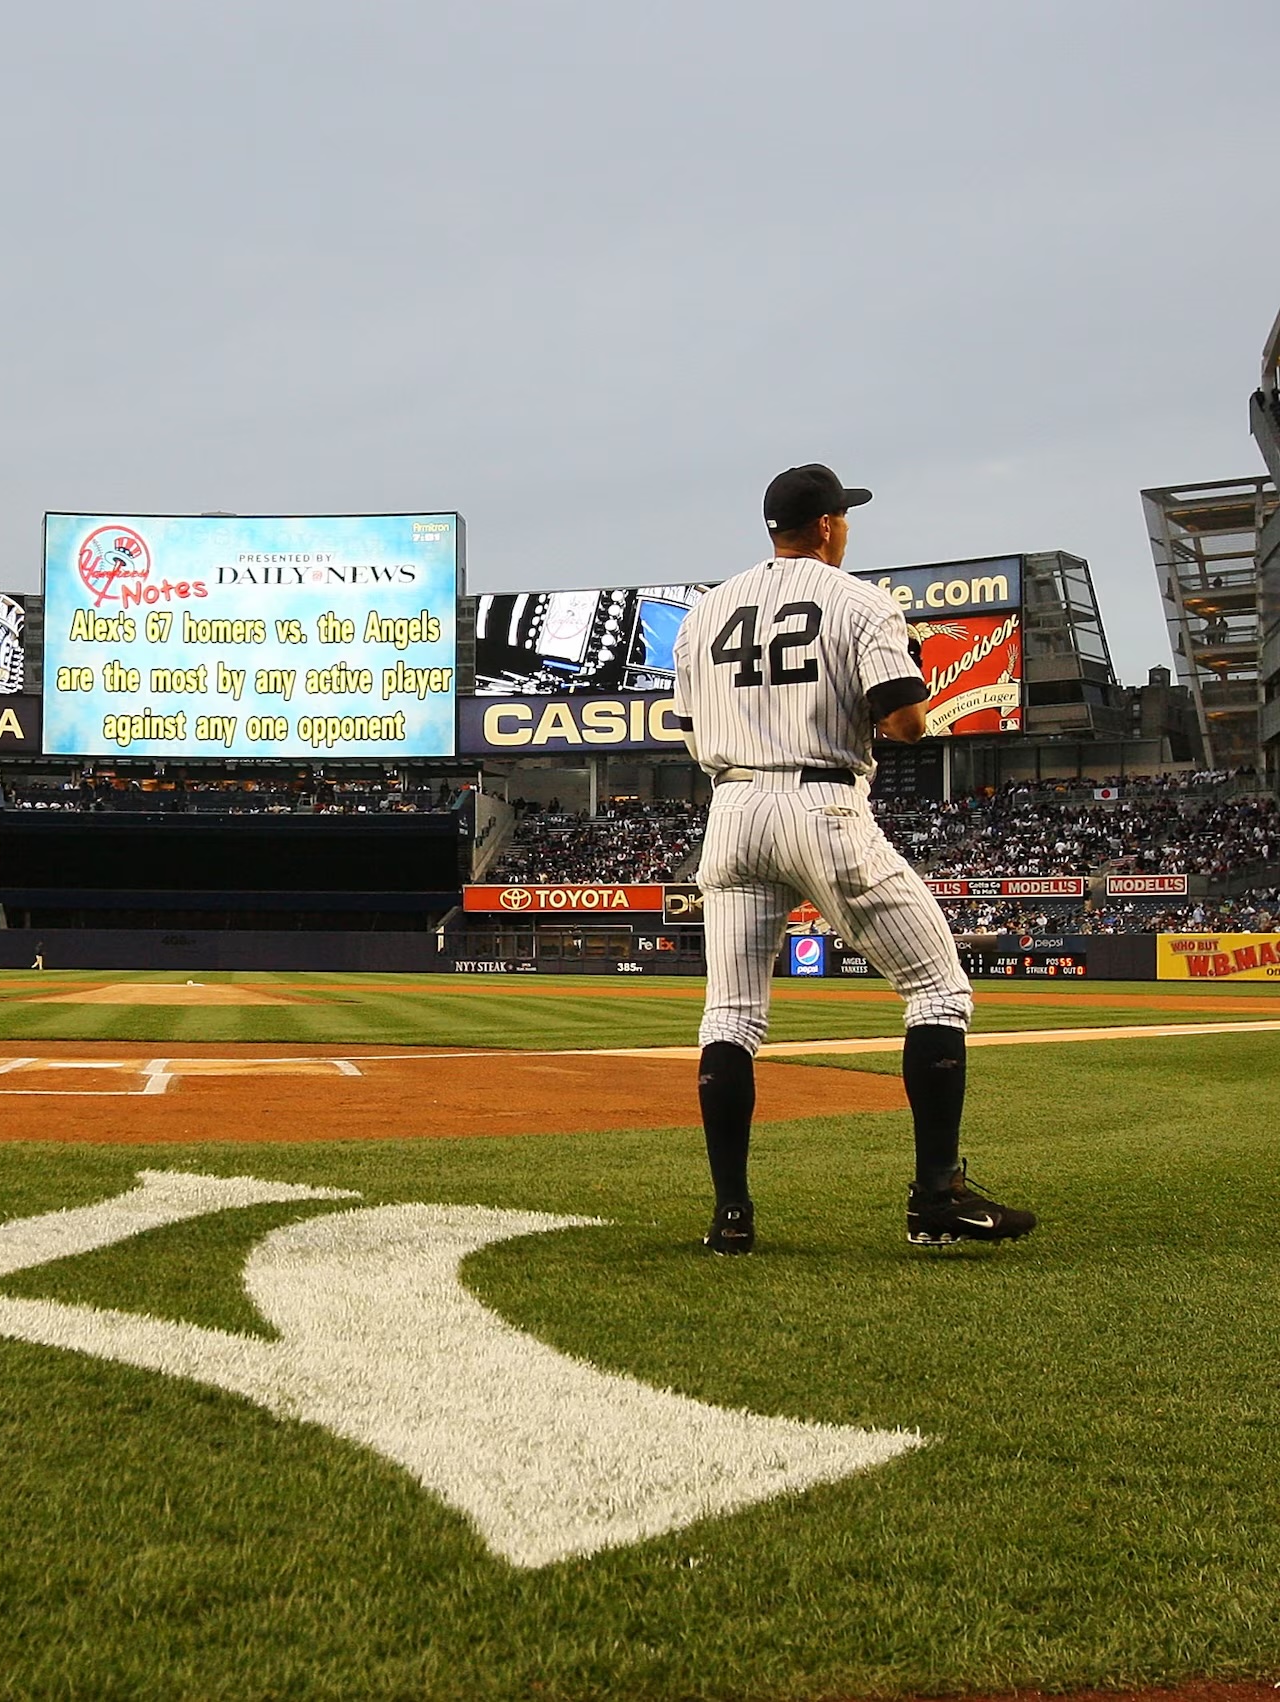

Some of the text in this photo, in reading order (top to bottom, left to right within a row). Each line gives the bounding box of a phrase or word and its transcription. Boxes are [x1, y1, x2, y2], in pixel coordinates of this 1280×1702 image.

[413, 523, 450, 532] Armitron
[239, 554, 332, 563] PRESENTED BY
[215, 565, 416, 584] DAILY NEWS
[121, 579, 208, 609] Notes
[70, 609, 440, 649] Alex's 67 homers vs. the Angels
[711, 601, 823, 688] 42
[926, 614, 1019, 700] dweiser
[56, 660, 452, 701] are the most by any active player
[932, 691, 1016, 729] American Lager
[103, 708, 406, 748] against any one opponent
[930, 883, 961, 895] ELL'S
[1008, 881, 1077, 894] MODELL'S
[1110, 878, 1184, 892] MODELL'S
[535, 889, 629, 909] TOYOTA
[1035, 938, 1063, 949] pepsi
[1170, 940, 1219, 952] WHO BUT
[455, 961, 477, 972] NYY
[477, 961, 507, 972] STEAK
[842, 957, 867, 965] ANGELS
[997, 958, 1005, 966] AT
[1006, 958, 1018, 966] BAT
[1024, 957, 1032, 966] 2
[1046, 958, 1059, 966] POS
[796, 965, 819, 974] pepsi
[841, 965, 868, 973] YANKEES
[990, 966, 1083, 975] BALL 0 STRIKE 0 OUT 0
[727, 1211, 741, 1220] 13
